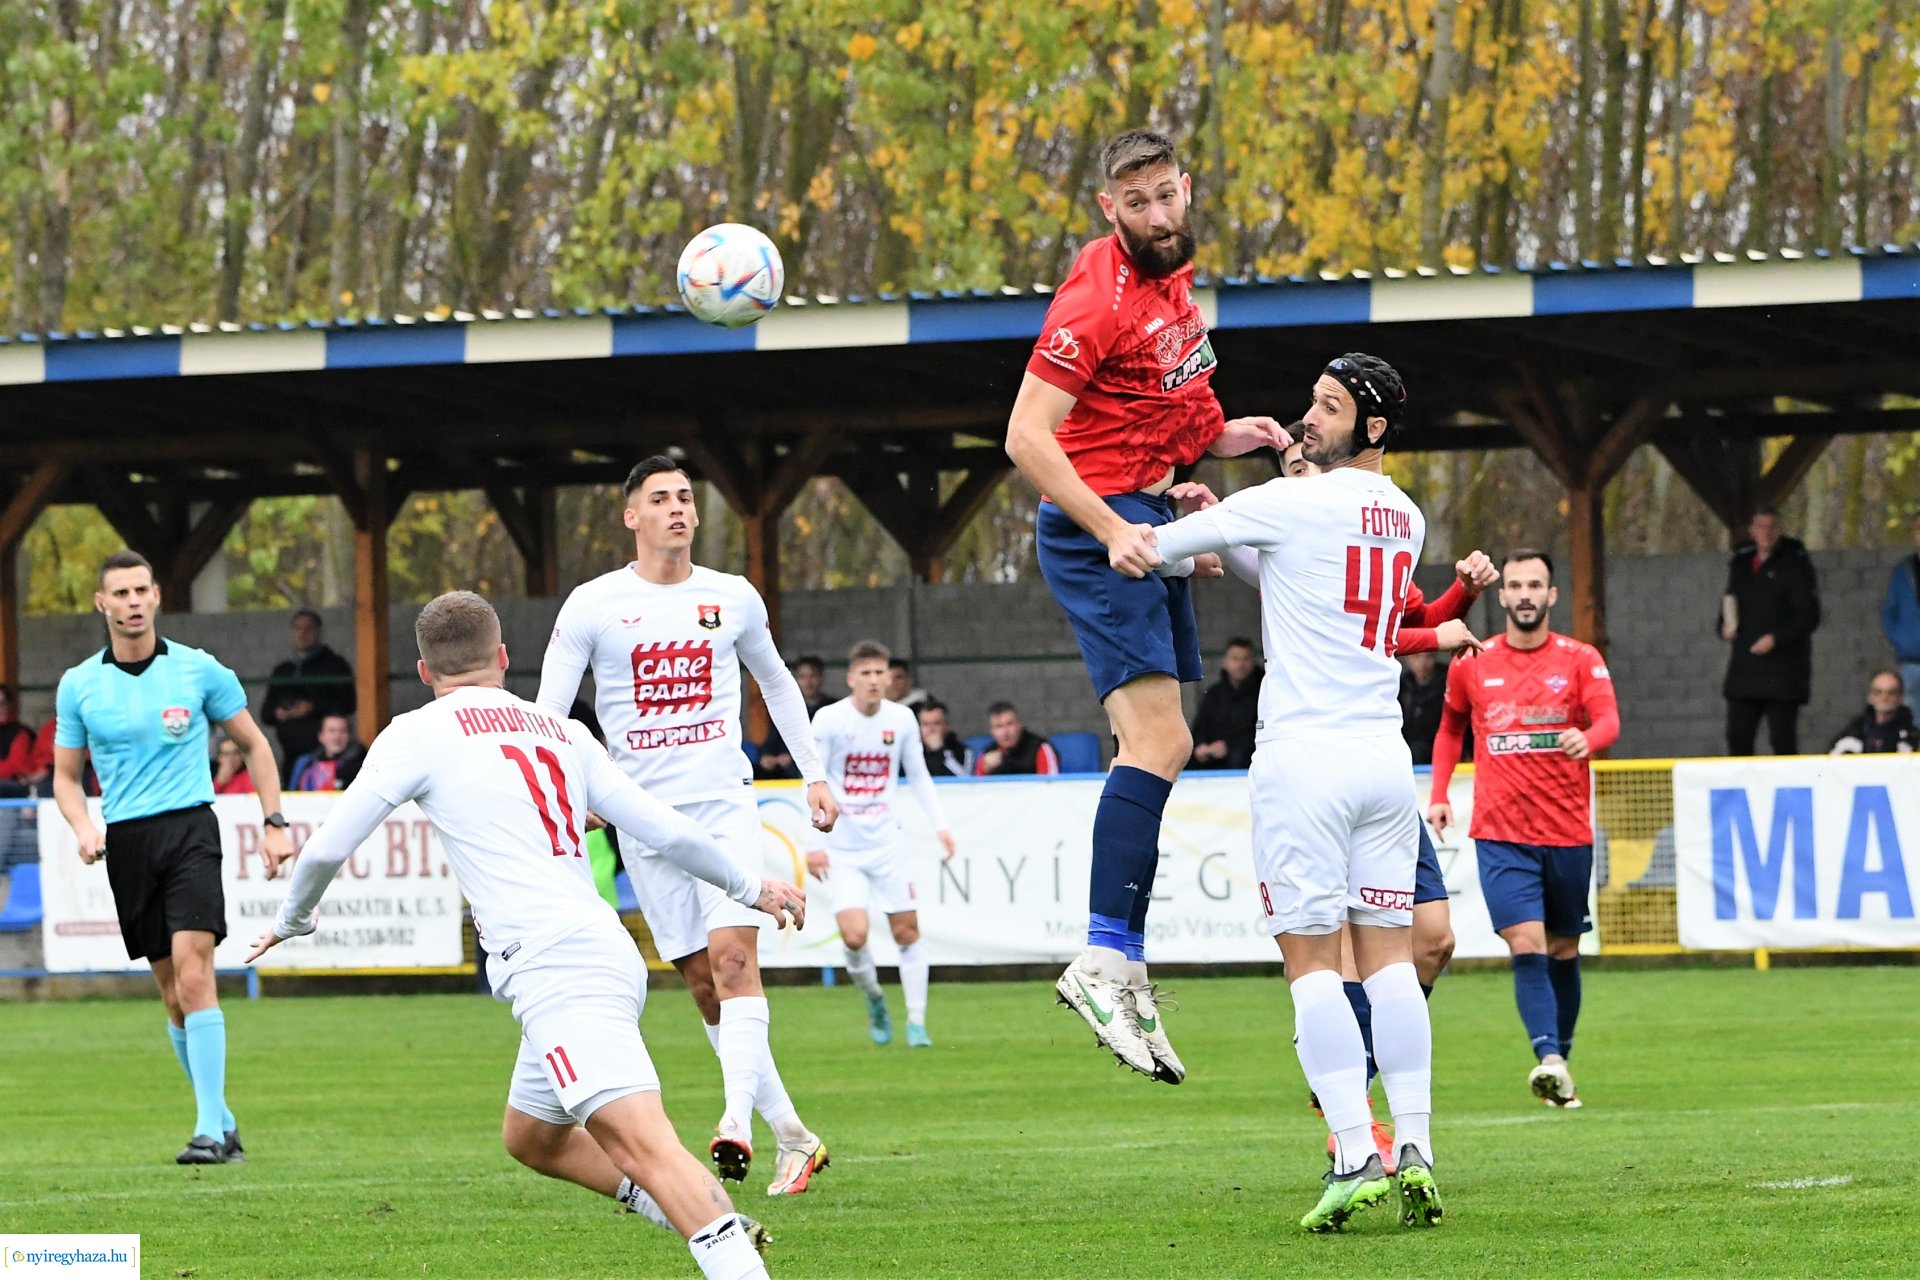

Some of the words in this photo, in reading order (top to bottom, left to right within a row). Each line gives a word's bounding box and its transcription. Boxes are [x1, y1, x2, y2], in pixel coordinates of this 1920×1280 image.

[1361, 500, 1411, 539] FÓTYIK
[1344, 545, 1412, 657] 48
[638, 681, 707, 701] PARK
[455, 704, 553, 738] HORVÁTH
[500, 744, 583, 858] 11
[1710, 784, 1915, 921] MA
[546, 1045, 578, 1089] 11
